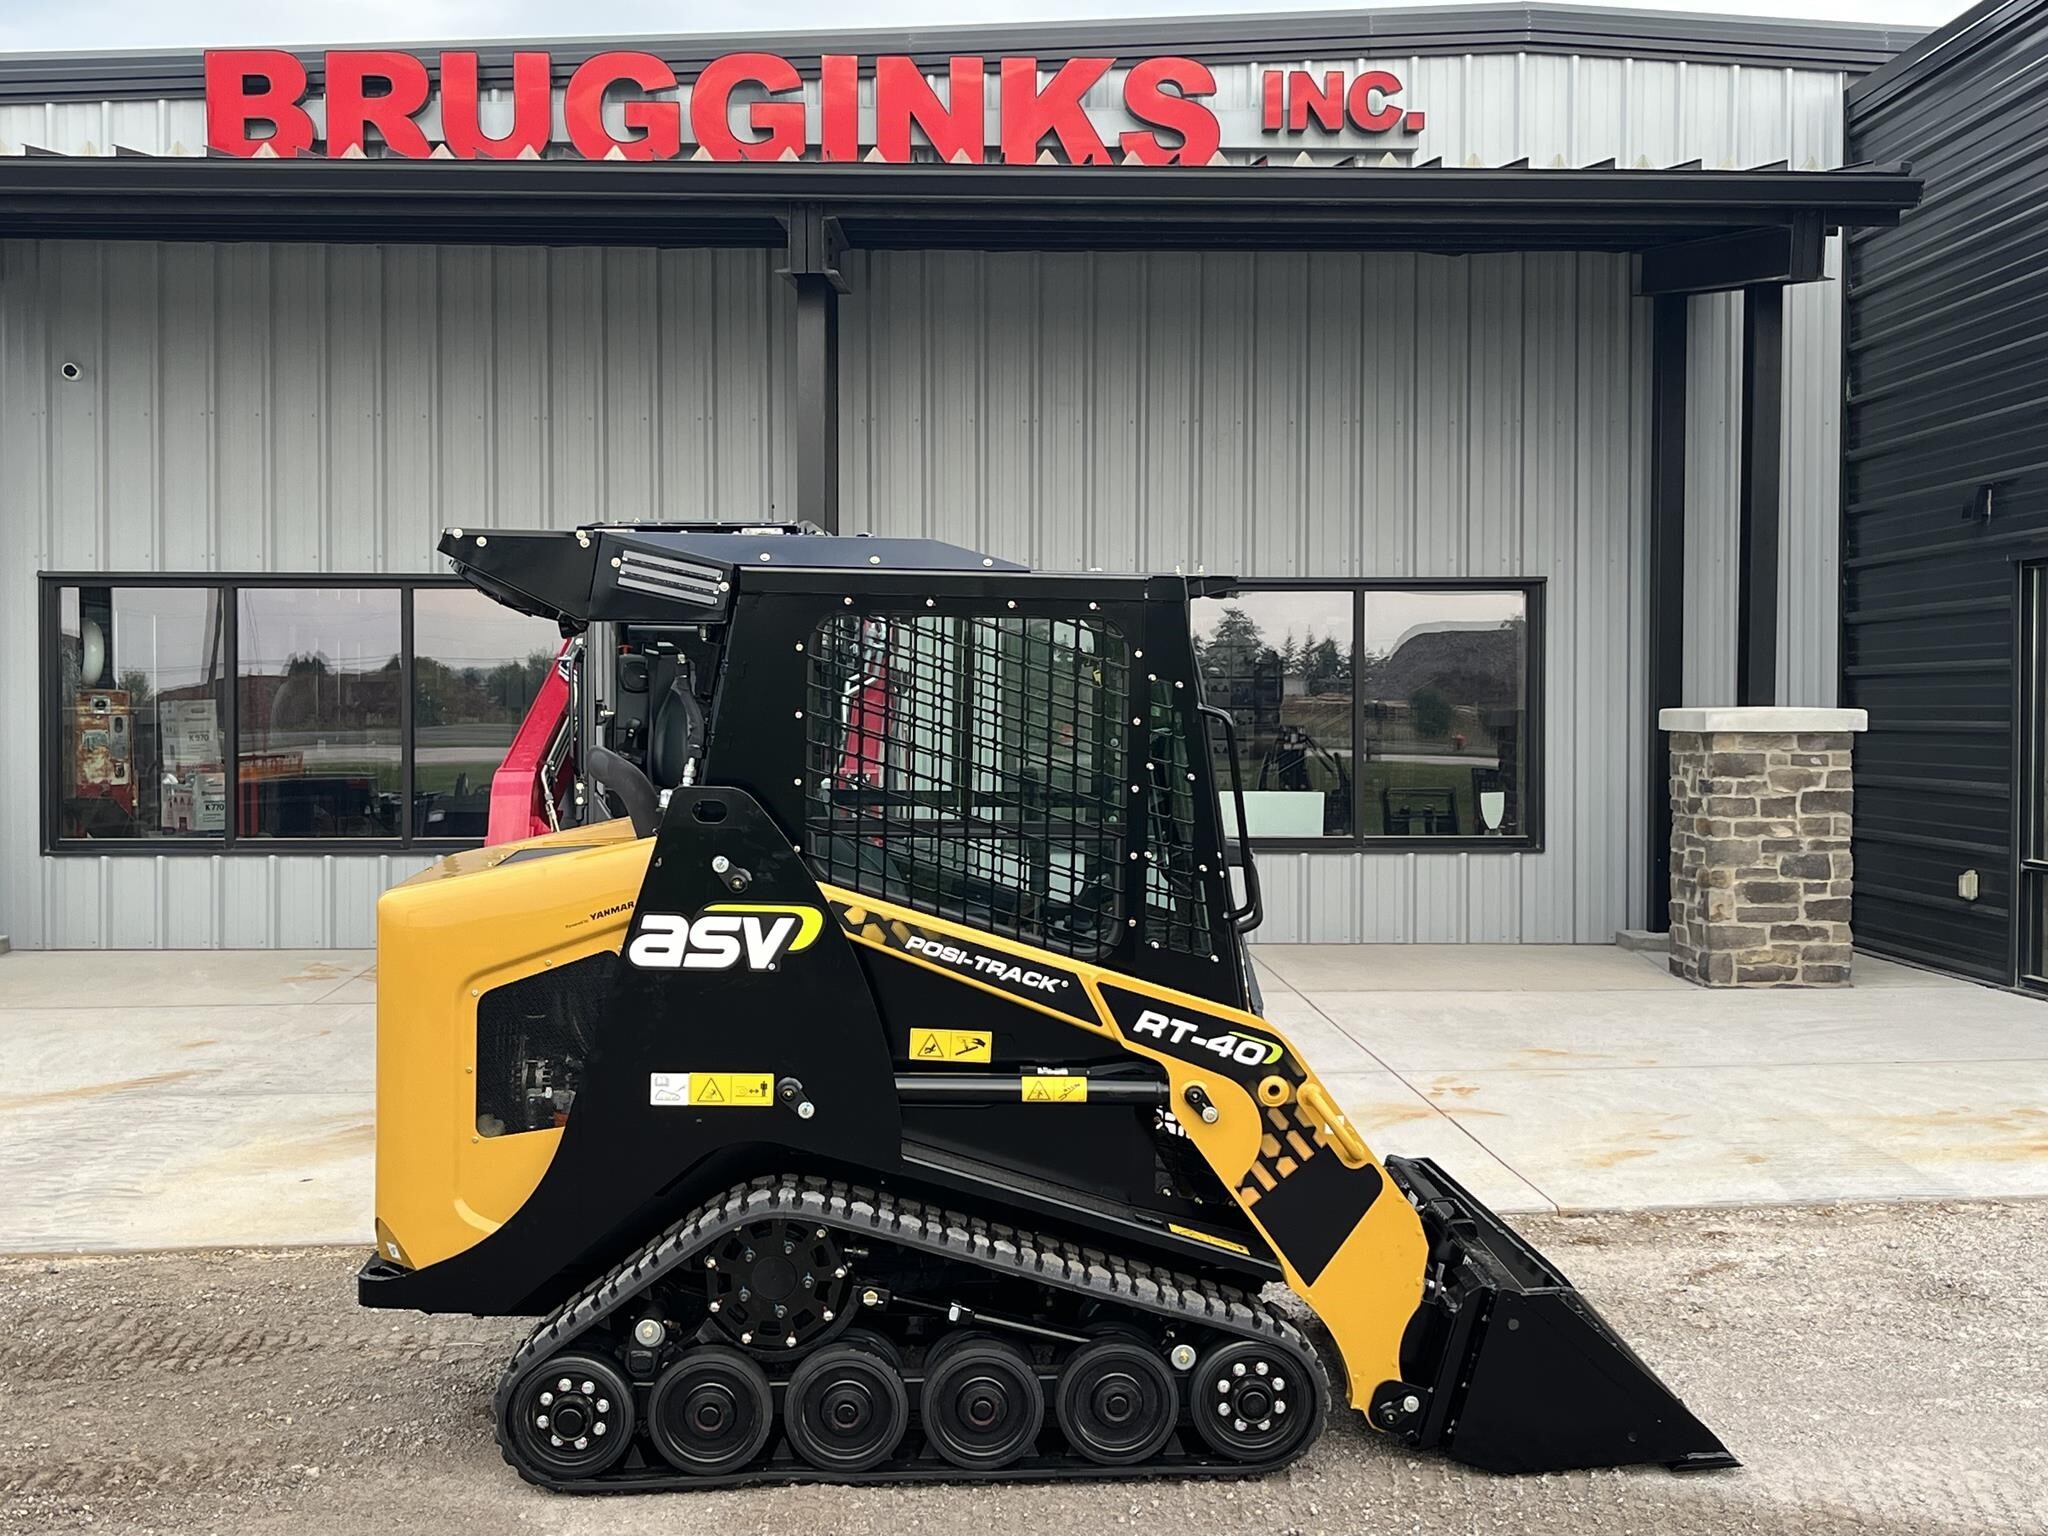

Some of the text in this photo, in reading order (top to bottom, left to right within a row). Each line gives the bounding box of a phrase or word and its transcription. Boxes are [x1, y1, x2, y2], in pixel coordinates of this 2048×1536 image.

[204, 50, 1425, 165] BRUGGINKS INC.
[589, 900, 635, 921] YANMAR
[1132, 1009, 1267, 1066] RT-40
